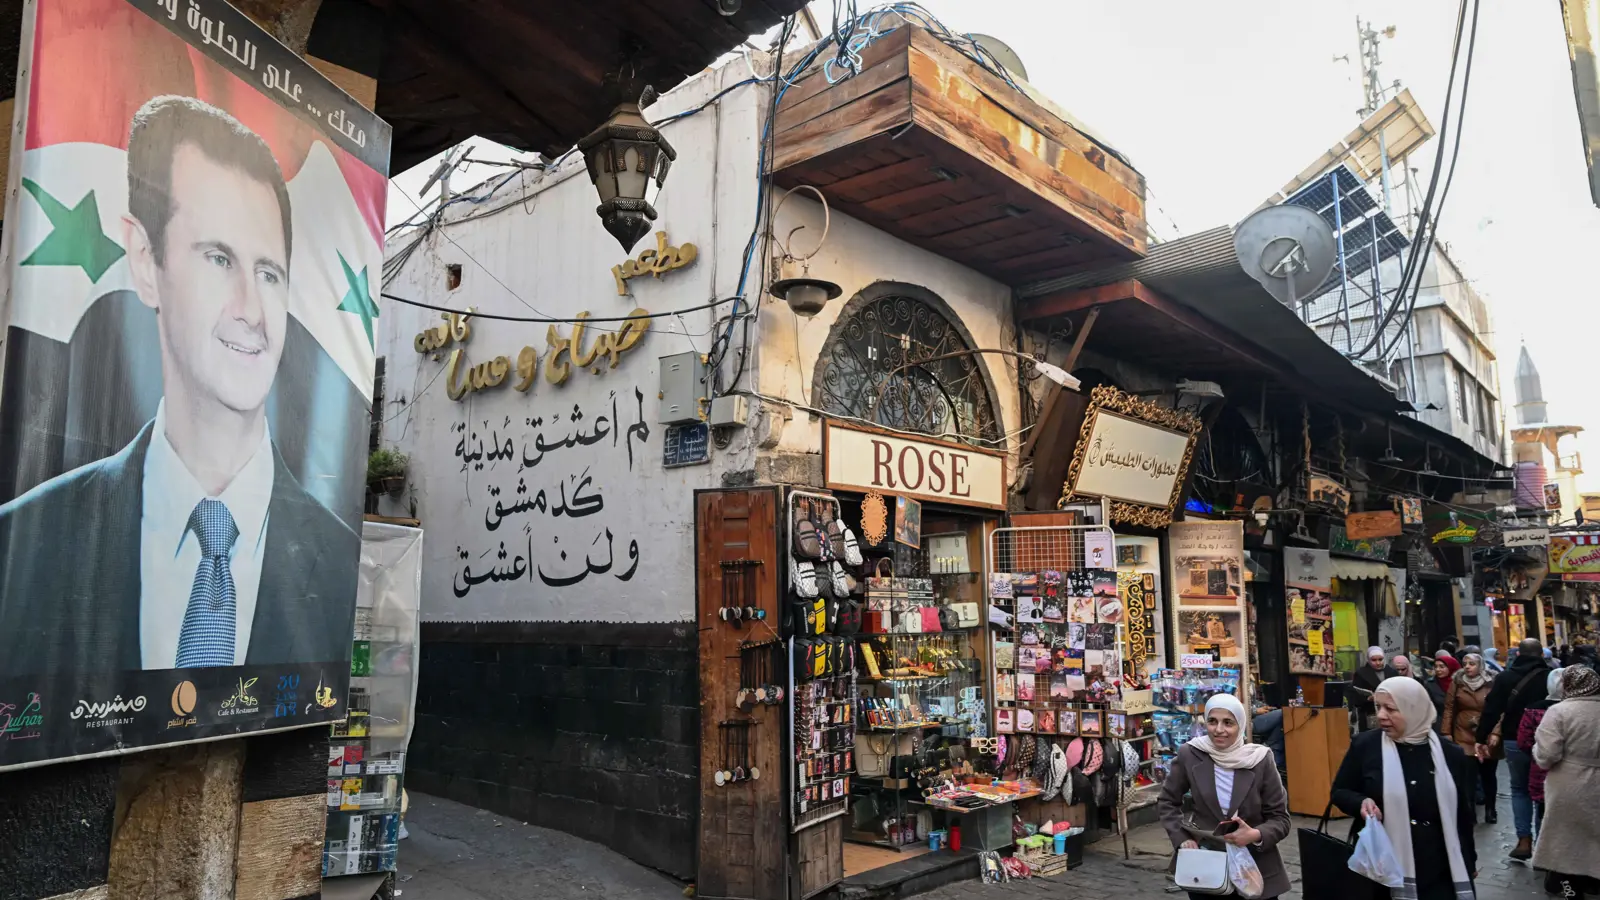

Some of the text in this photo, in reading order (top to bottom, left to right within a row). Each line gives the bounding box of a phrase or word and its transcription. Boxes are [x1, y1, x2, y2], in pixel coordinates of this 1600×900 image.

[186, 1, 258, 71] الحلوة
[263, 64, 302, 102] على
[328, 109, 366, 148] معك
[611, 230, 698, 296] مطعم
[545, 307, 650, 386] صباح
[626, 385, 651, 472] لم
[871, 439, 971, 497] ROSE
[1181, 658, 1212, 666] 25000
[86, 717, 134, 728] RESTAURANT
[235, 707, 259, 715] Restaurant
